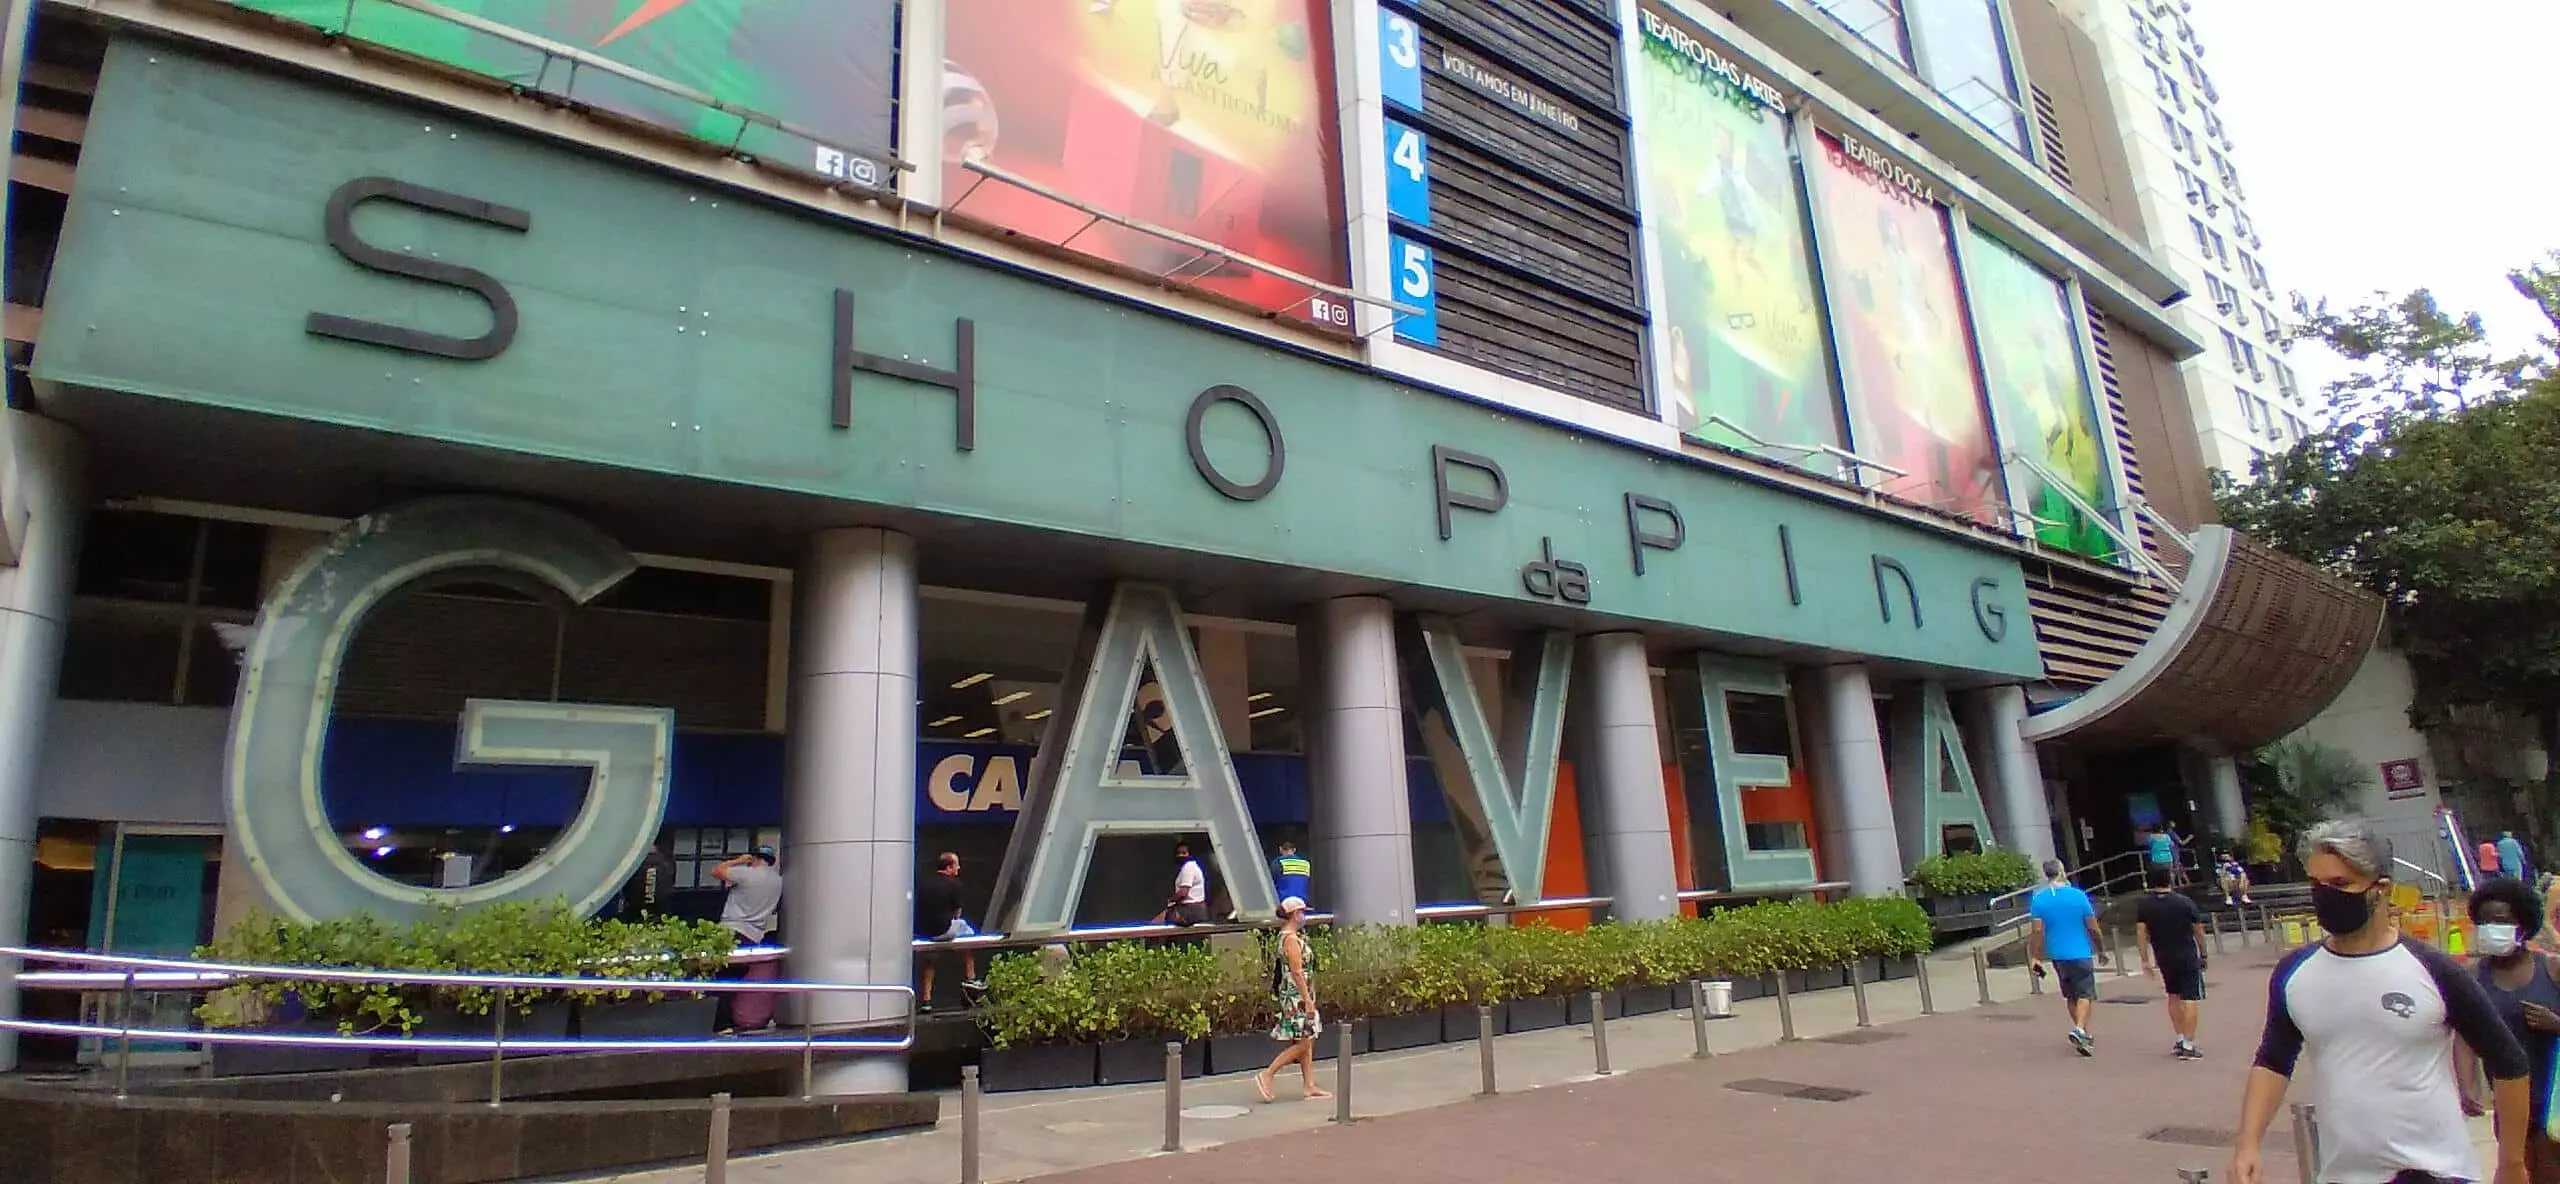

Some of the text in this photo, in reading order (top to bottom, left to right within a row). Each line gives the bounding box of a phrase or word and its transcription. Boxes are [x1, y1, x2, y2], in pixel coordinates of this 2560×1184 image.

[1156, 17, 1228, 85] Viva
[1388, 17, 1416, 69] 3
[1641, 7, 1786, 114] TEATRO DAS ARTES
[1442, 50, 1510, 97] VOLTAMOS
[1510, 85, 1529, 107] EM
[1393, 130, 1424, 182] 4
[1843, 132, 1934, 206] TEATRO DOS 4
[1402, 244, 1430, 298] 5
[1521, 536, 1592, 603] da
[222, 494, 1998, 934] GAVEA
